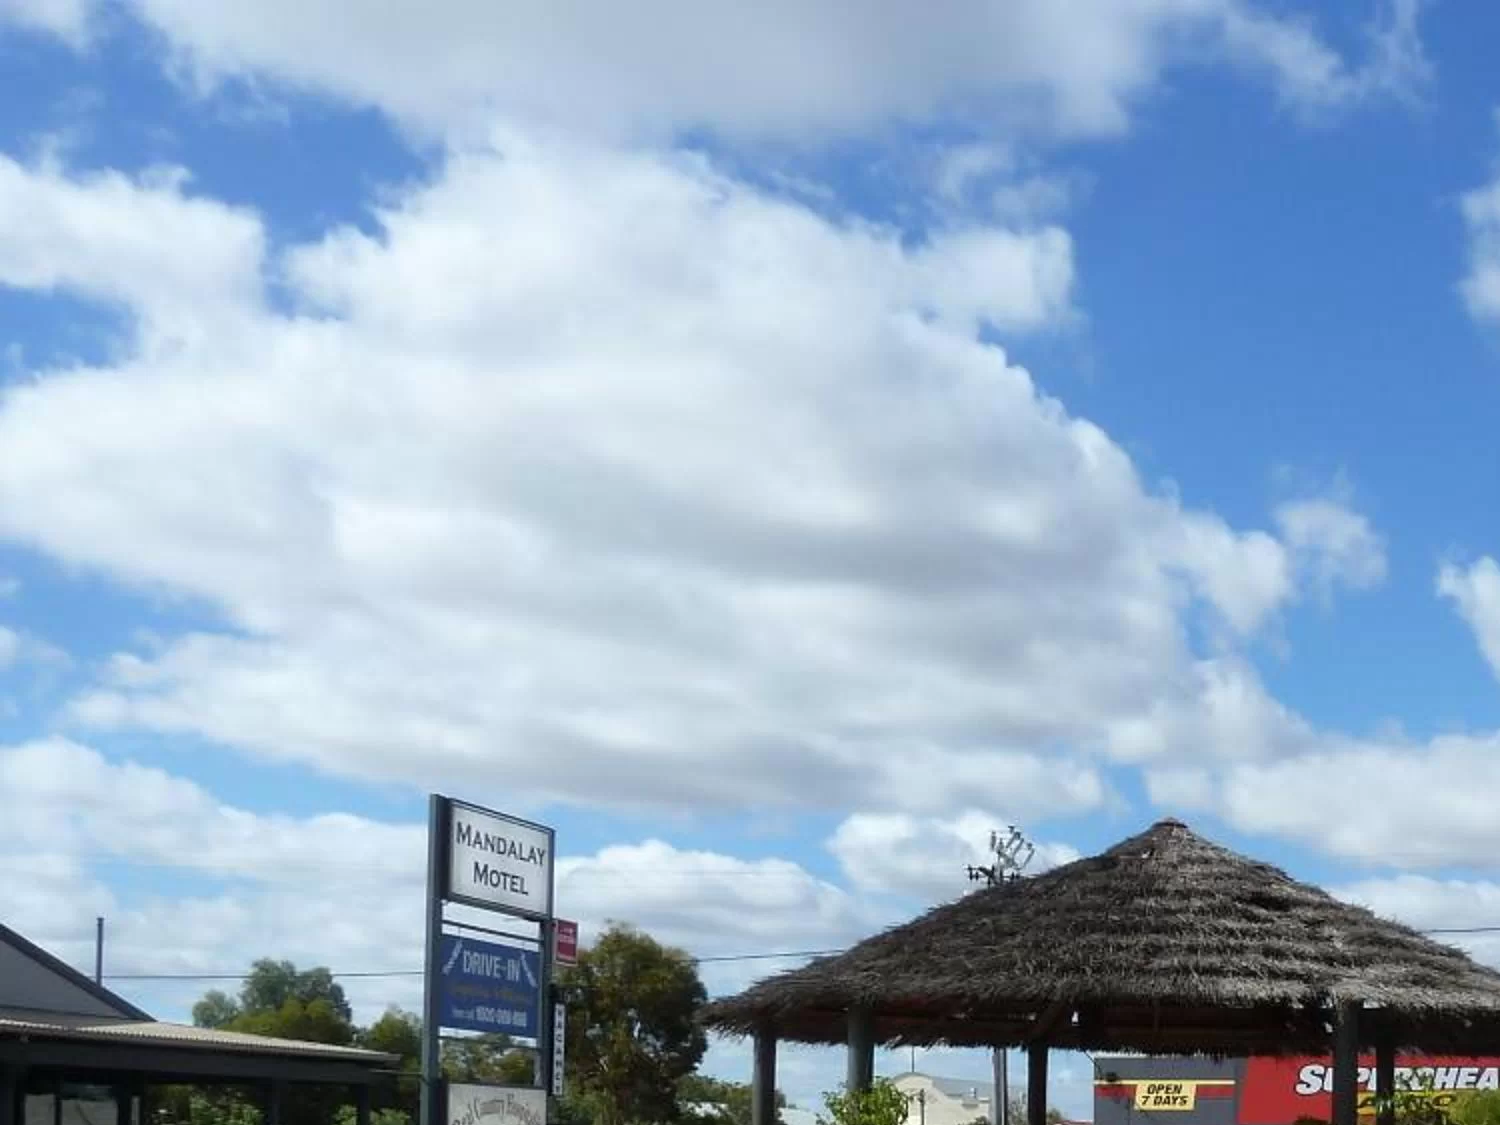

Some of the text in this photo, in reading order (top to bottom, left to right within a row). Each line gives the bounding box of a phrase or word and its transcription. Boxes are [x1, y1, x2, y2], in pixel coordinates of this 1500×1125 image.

[456, 821, 546, 867] MANDALAY
[473, 861, 529, 896] MOTEL
[463, 949, 520, 983] DRIVE-IN
[1141, 1095, 1189, 1106] 7 DAYS
[1147, 1084, 1183, 1094] OPEN
